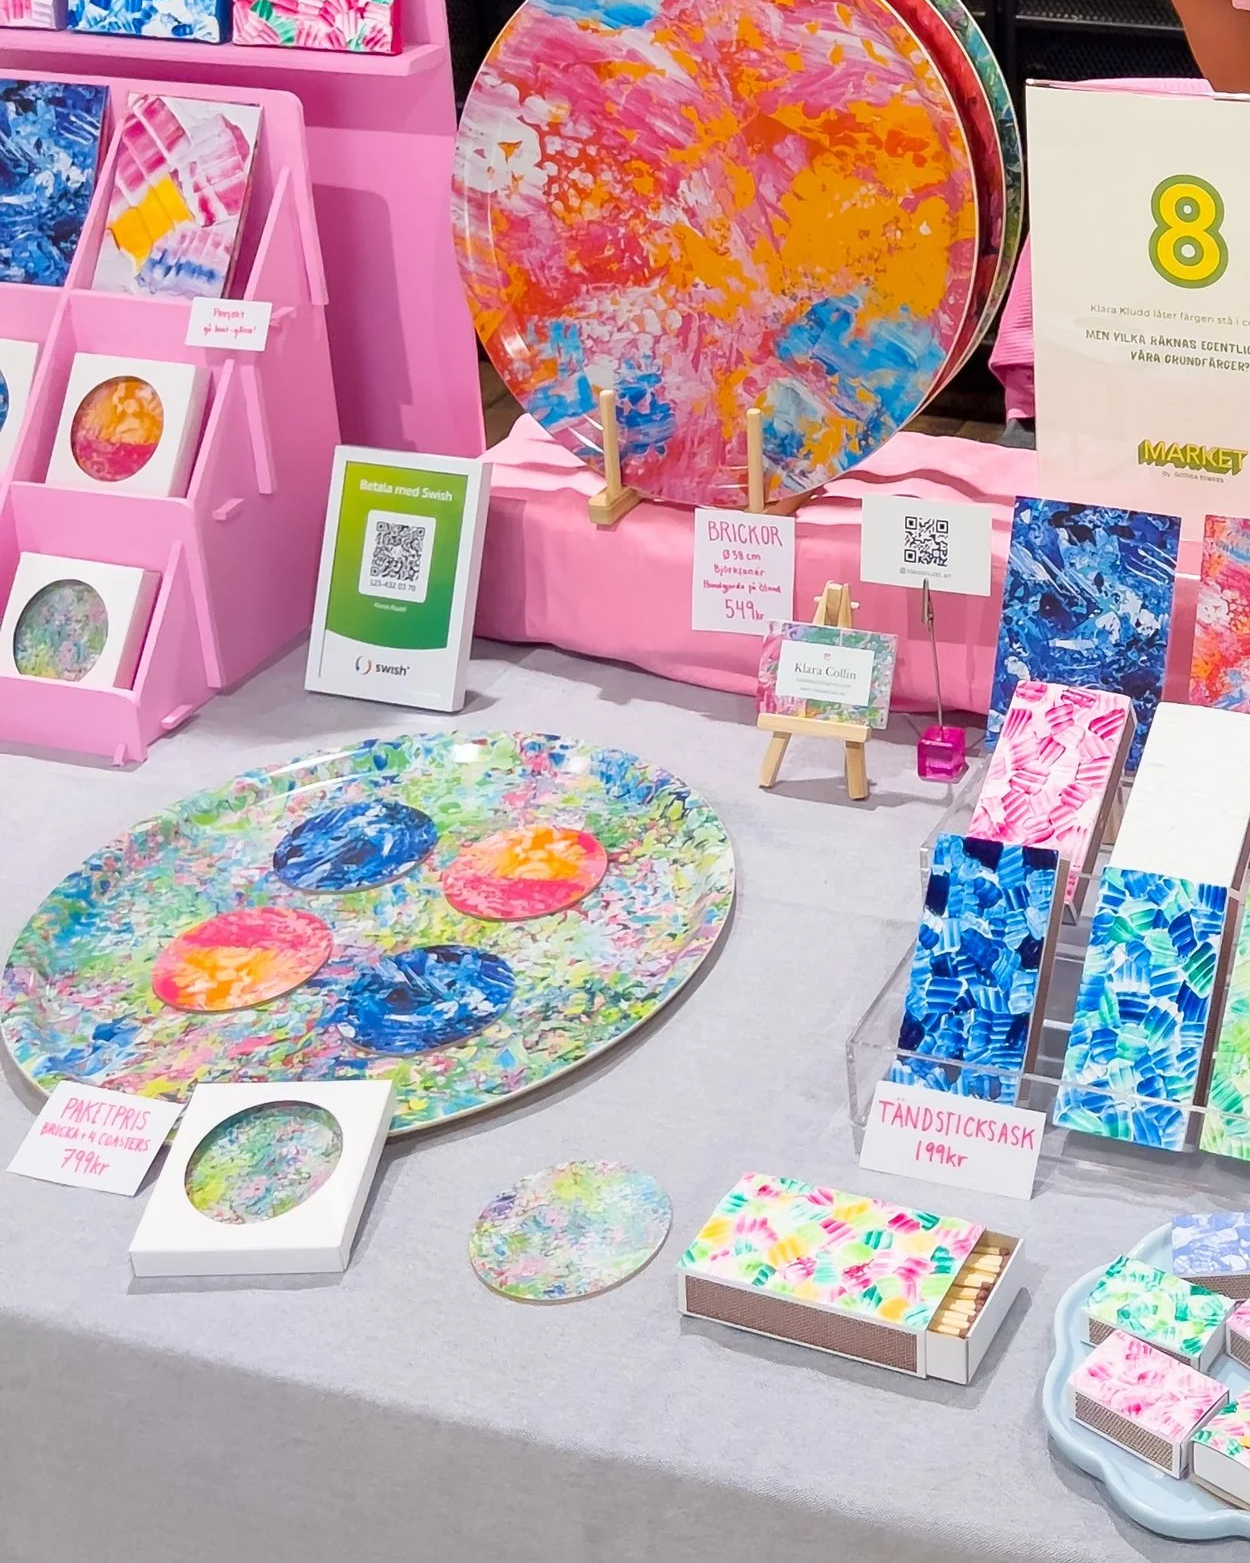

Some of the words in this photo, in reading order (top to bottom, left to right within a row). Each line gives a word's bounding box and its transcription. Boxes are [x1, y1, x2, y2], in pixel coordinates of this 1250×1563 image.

[1148, 174, 1229, 289] 8
[1090, 303, 1117, 315] Klara
[1119, 306, 1151, 318] Kludd
[1153, 308, 1177, 320] låter
[1180, 311, 1215, 324] färgen
[1217, 315, 1233, 326] stå
[1086, 329, 1110, 341] MEN
[1113, 331, 1146, 345] VILKA
[1150, 335, 1197, 350] RÄKNAS
[1130, 349, 1161, 364] VÅRA
[1164, 353, 1250, 372] GRUNDFÄRGER?
[1138, 438, 1248, 476] MARKET
[360, 479, 393, 494] Betala
[394, 485, 420, 498] med
[422, 487, 453, 502] Swish
[708, 521, 783, 547] BRICKOR
[746, 553, 761, 561] cm
[725, 599, 764, 621] 549kr
[375, 664, 408, 676] swish
[794, 662, 822, 676] Klara
[825, 666, 857, 680] Collin
[60, 1097, 152, 1131] PAKETPRIS
[879, 1097, 1035, 1150] TÄNDSTICKSASK
[40, 1121, 79, 1139] BRICKA
[99, 1132, 151, 1152] COASTERS
[61, 1148, 110, 1176] 799kr
[915, 1140, 968, 1167] 199kr
